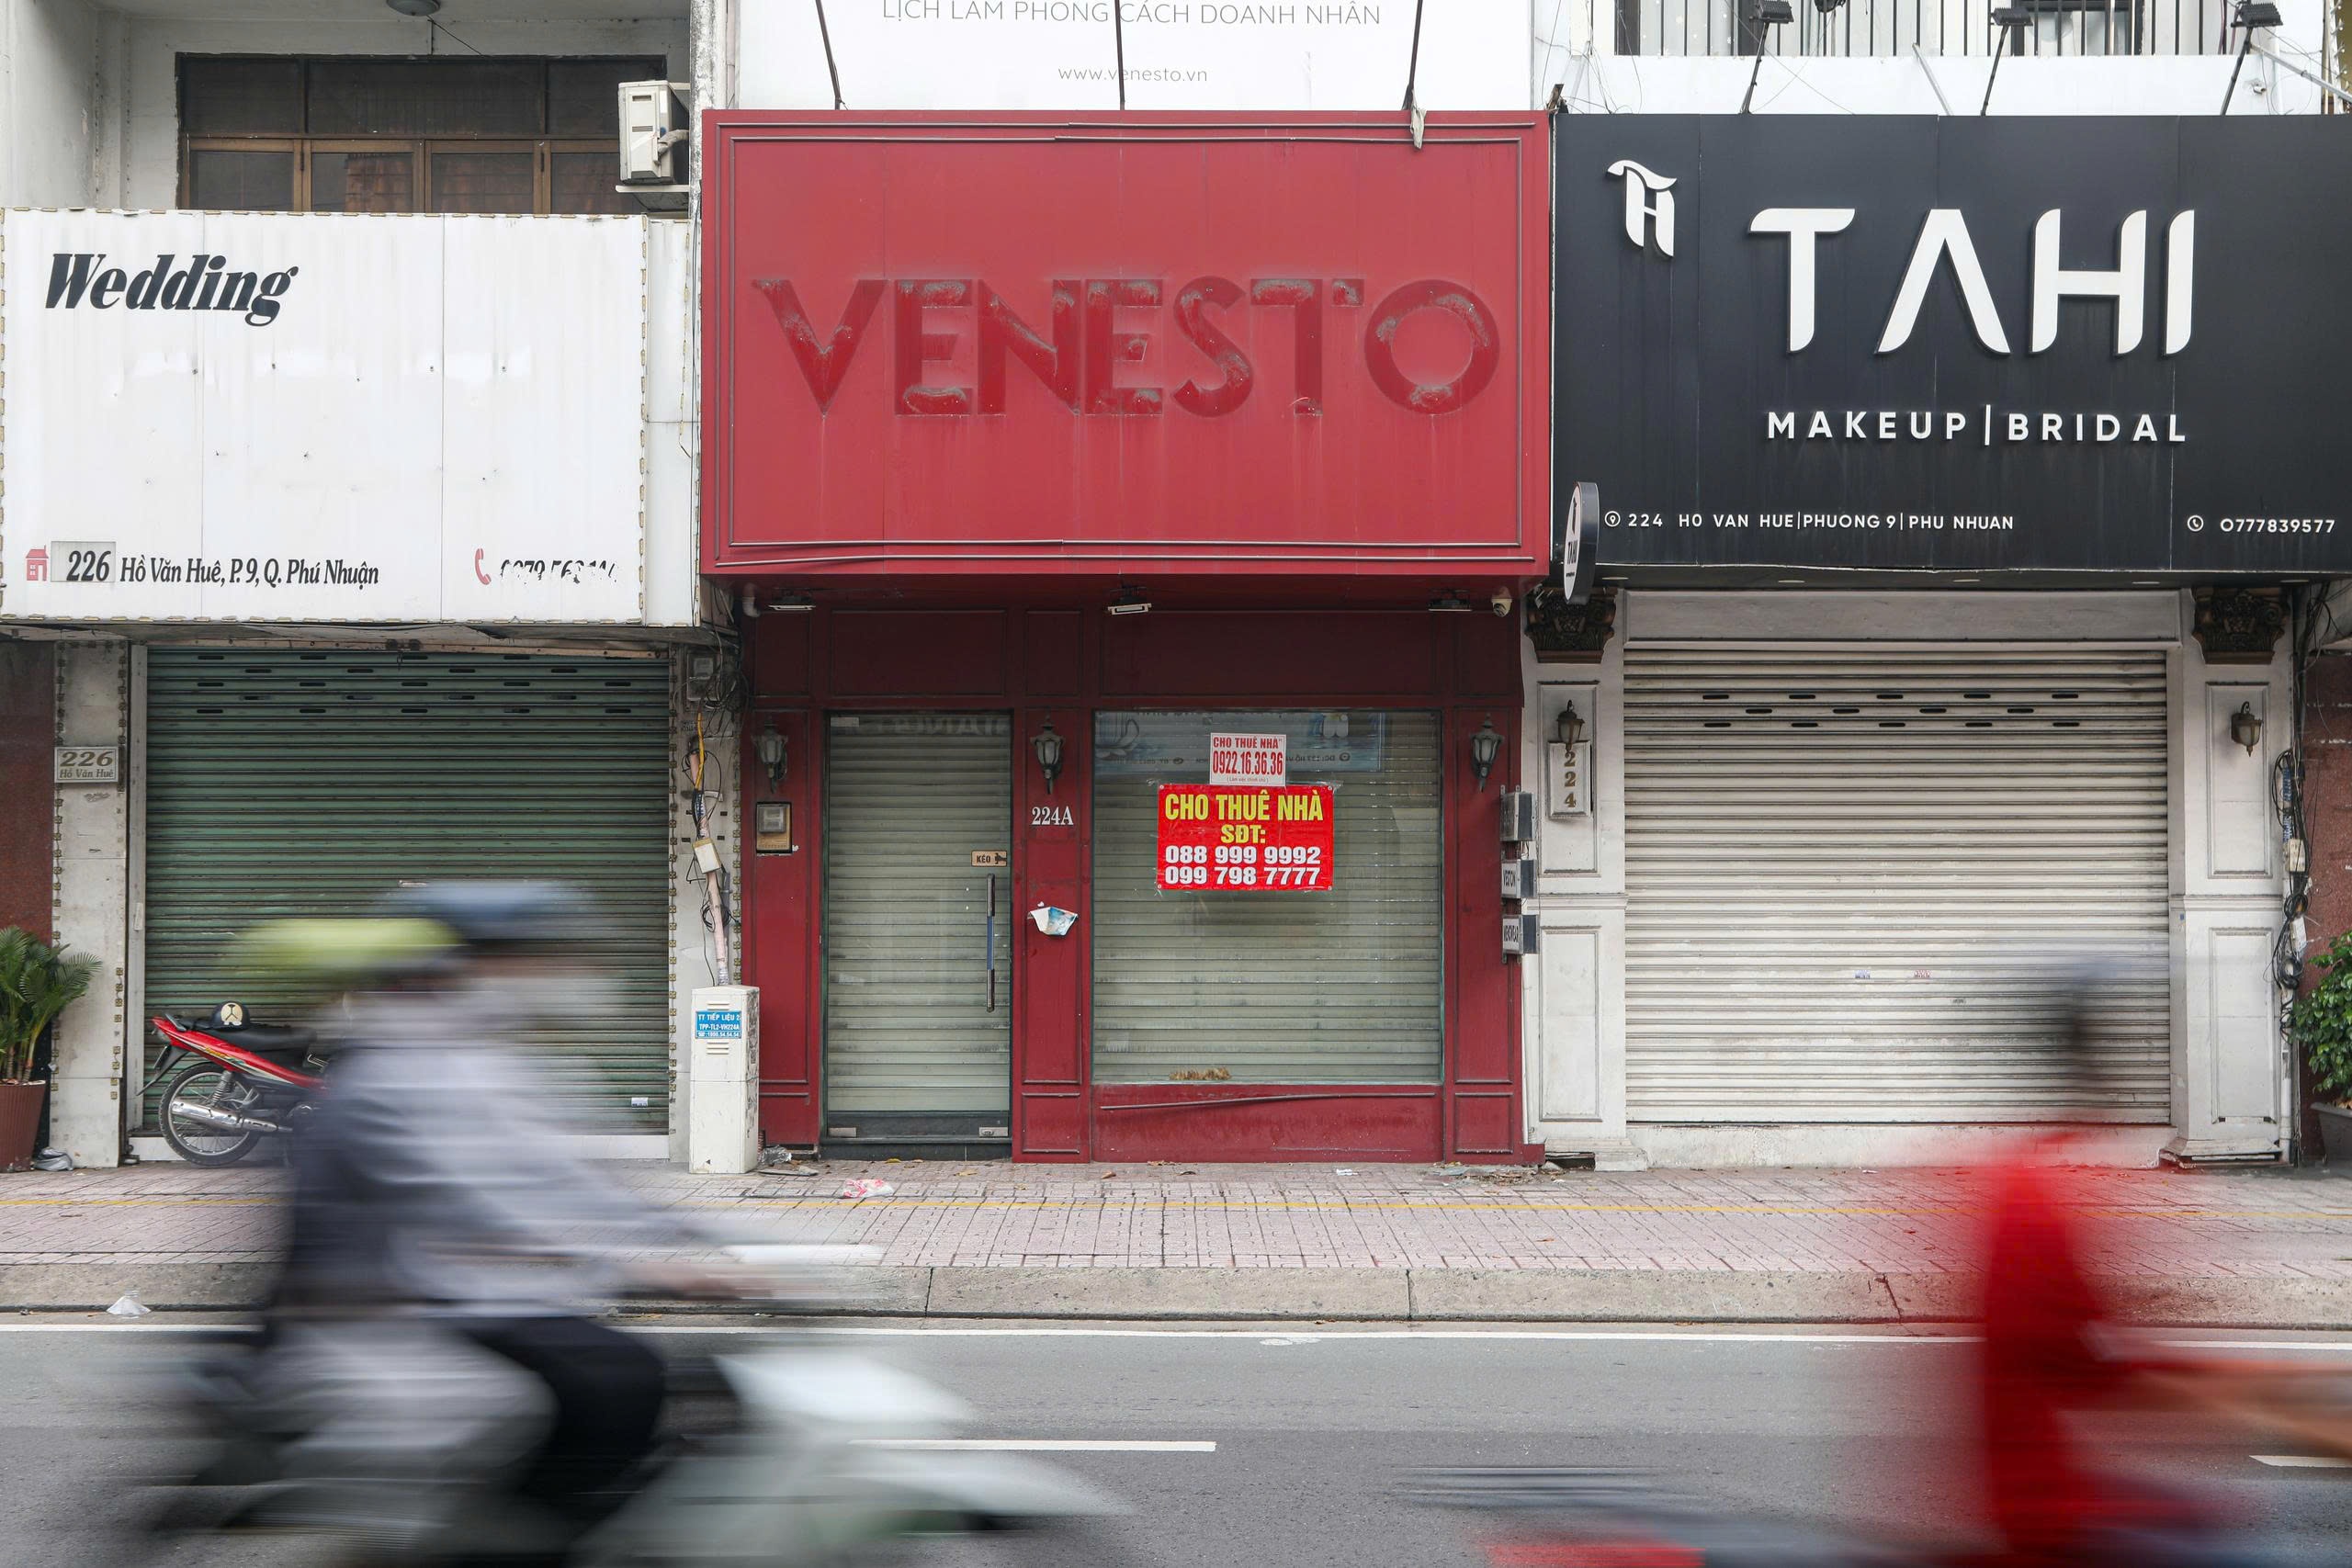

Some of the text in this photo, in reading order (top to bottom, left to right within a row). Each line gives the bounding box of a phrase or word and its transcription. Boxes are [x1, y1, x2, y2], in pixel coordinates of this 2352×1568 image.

[883, 0, 939, 21] LỊCH
[1014, 1, 1109, 22] PHONG
[1119, 0, 1190, 23] CÁCH
[1200, 5, 1295, 24] DOANH
[1306, 0, 1380, 24] NHÂN
[1057, 67, 1208, 82] www.venesto.vn
[45, 253, 300, 327] Wedding
[1747, 208, 2196, 356] TAHI
[752, 275, 1500, 418] VENESTO
[1767, 410, 2188, 443] MAKEUP BRIDAL
[1628, 513, 1663, 527] 224
[1713, 513, 1749, 528] VAN
[1908, 515, 1944, 529] PHU
[1952, 515, 2014, 530] NHUAN
[66, 550, 111, 582] 226
[119, 554, 146, 582] Hồ
[151, 558, 182, 583] Văn
[186, 558, 225, 587] Huê,
[264, 558, 282, 589] Q.
[286, 558, 321, 584] Phú
[323, 558, 379, 590] Nhuận
[1213, 737, 1232, 748] CHO
[1235, 736, 1258, 749] THUÊ
[60, 750, 113, 766] 226
[1213, 750, 1283, 776] 0922.16.36.36
[1564, 750, 1577, 808] 224
[1165, 789, 1324, 821] CHO THUÊ NHÀ
[1031, 806, 1074, 826] 224A
[1220, 824, 1266, 844] SĐT:
[976, 852, 991, 863] KÉO
[1165, 845, 1321, 864] 088 999 9992
[1165, 865, 1321, 886] 099 798 7777
[698, 1013, 706, 1021] TT
[707, 1012, 720, 1021] TIẾP
[721, 1013, 735, 1022] LIỆU
